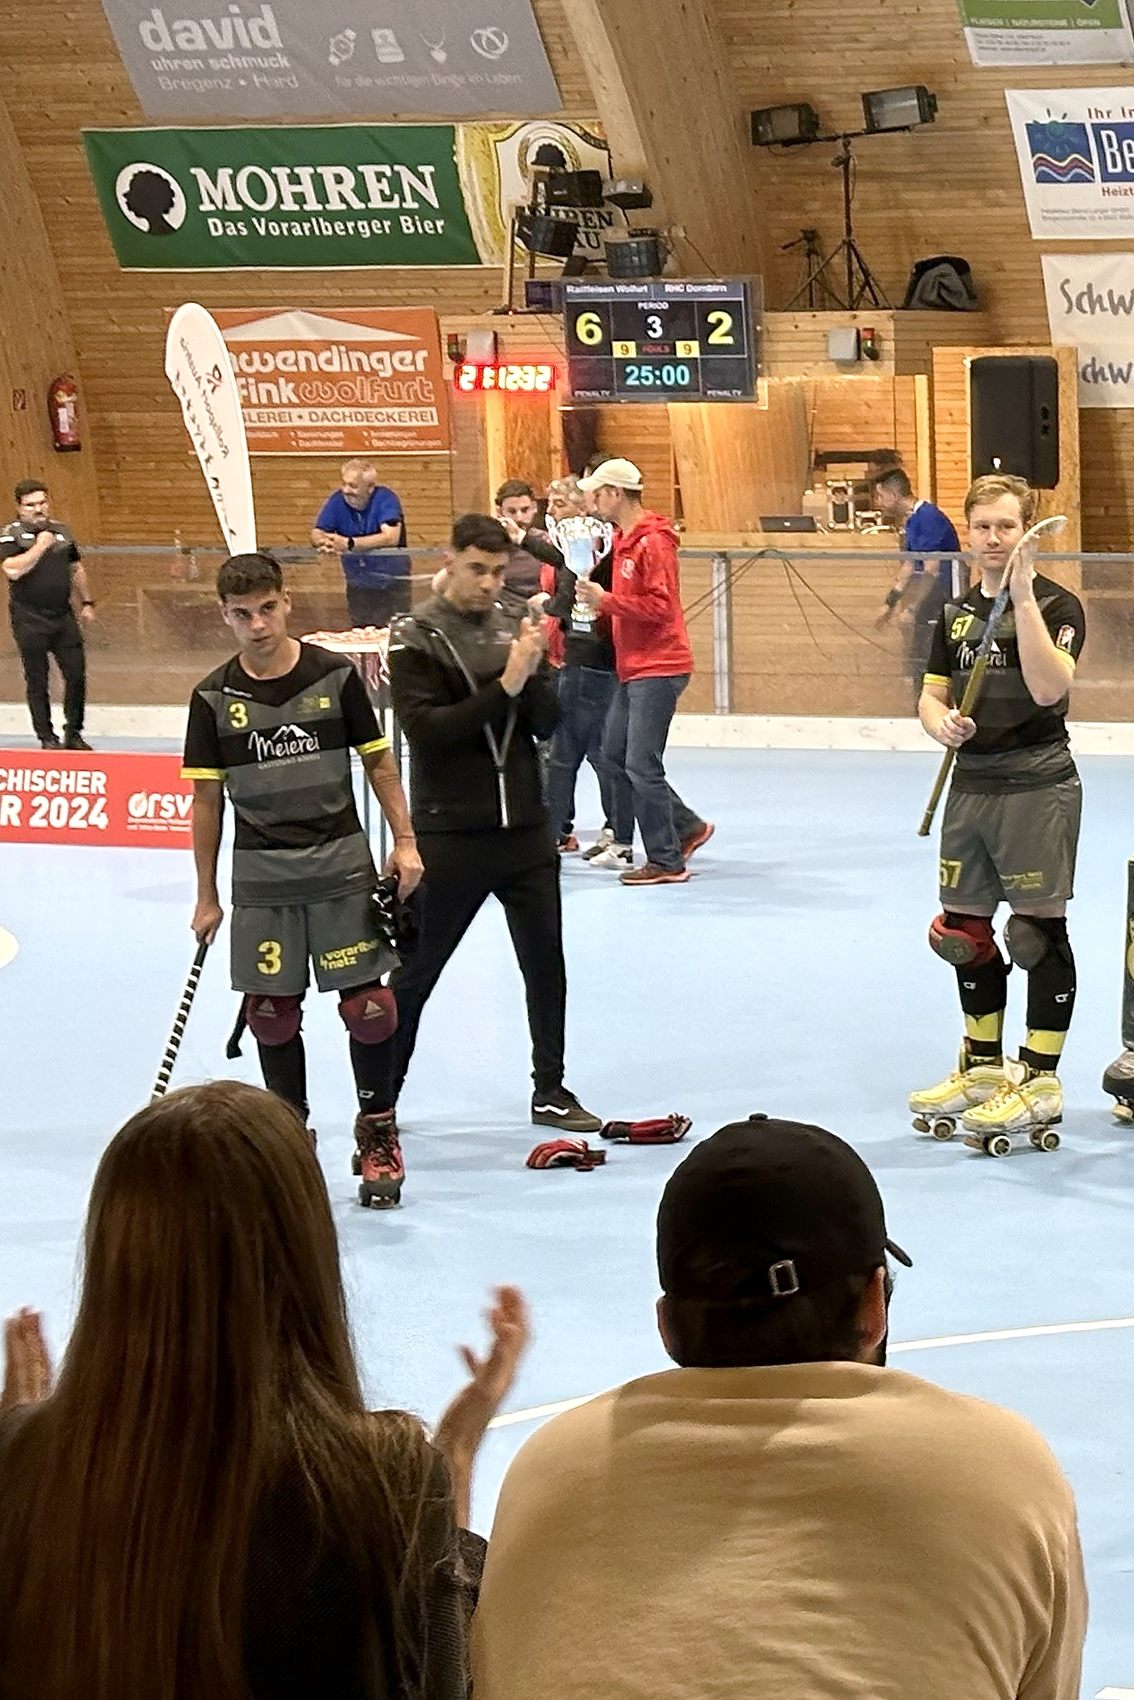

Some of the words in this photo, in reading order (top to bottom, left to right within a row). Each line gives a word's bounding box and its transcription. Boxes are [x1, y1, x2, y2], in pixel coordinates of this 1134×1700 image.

[139, 4, 284, 51] david
[151, 56, 204, 71] uhren
[208, 52, 291, 71] schmuck
[158, 75, 233, 92] Bregenz
[252, 73, 299, 89] Hard
[1087, 107, 1113, 120] Ihr
[190, 165, 440, 212] MOHREN
[207, 217, 249, 237] Das
[252, 216, 392, 239] Vorarlberger
[399, 215, 445, 235] Bier
[637, 302, 669, 310] PERIOD
[575, 311, 603, 346] 6
[646, 315, 663, 339] 3
[706, 310, 735, 345] 2
[620, 344, 630, 356] 9
[683, 344, 692, 355] 9
[625, 364, 690, 386] 25:00
[308, 409, 435, 424] DACHDECKEREI
[950, 614, 975, 640] 57
[229, 702, 249, 729] 3
[247, 730, 321, 761] Meierei
[28, 795, 109, 831] 2024
[257, 940, 281, 975] 3
